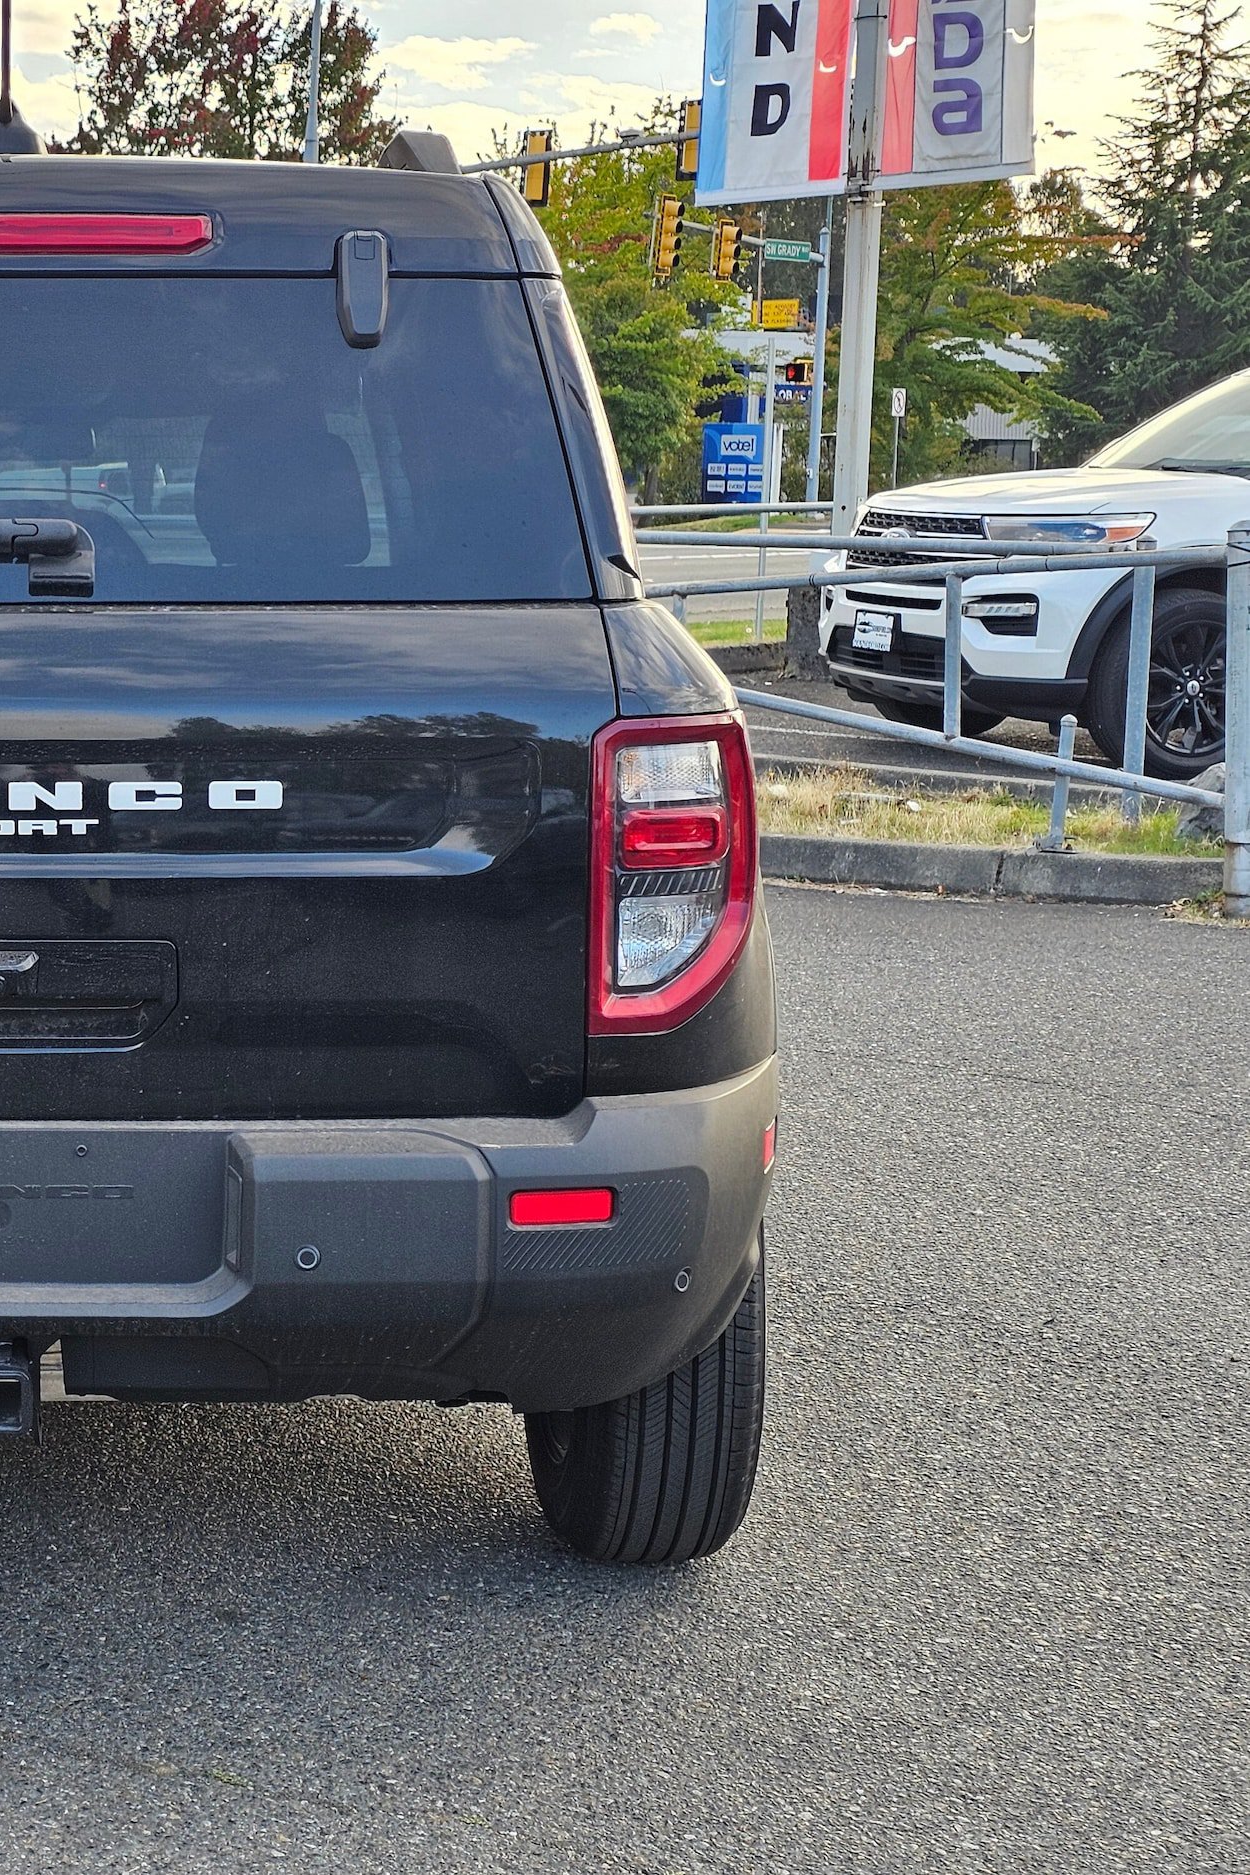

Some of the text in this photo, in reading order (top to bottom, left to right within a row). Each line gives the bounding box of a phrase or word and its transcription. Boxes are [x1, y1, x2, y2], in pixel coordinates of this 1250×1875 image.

[766, 243, 777, 255] SW
[777, 243, 801, 257] GRADY
[723, 438, 755, 452] vote!
